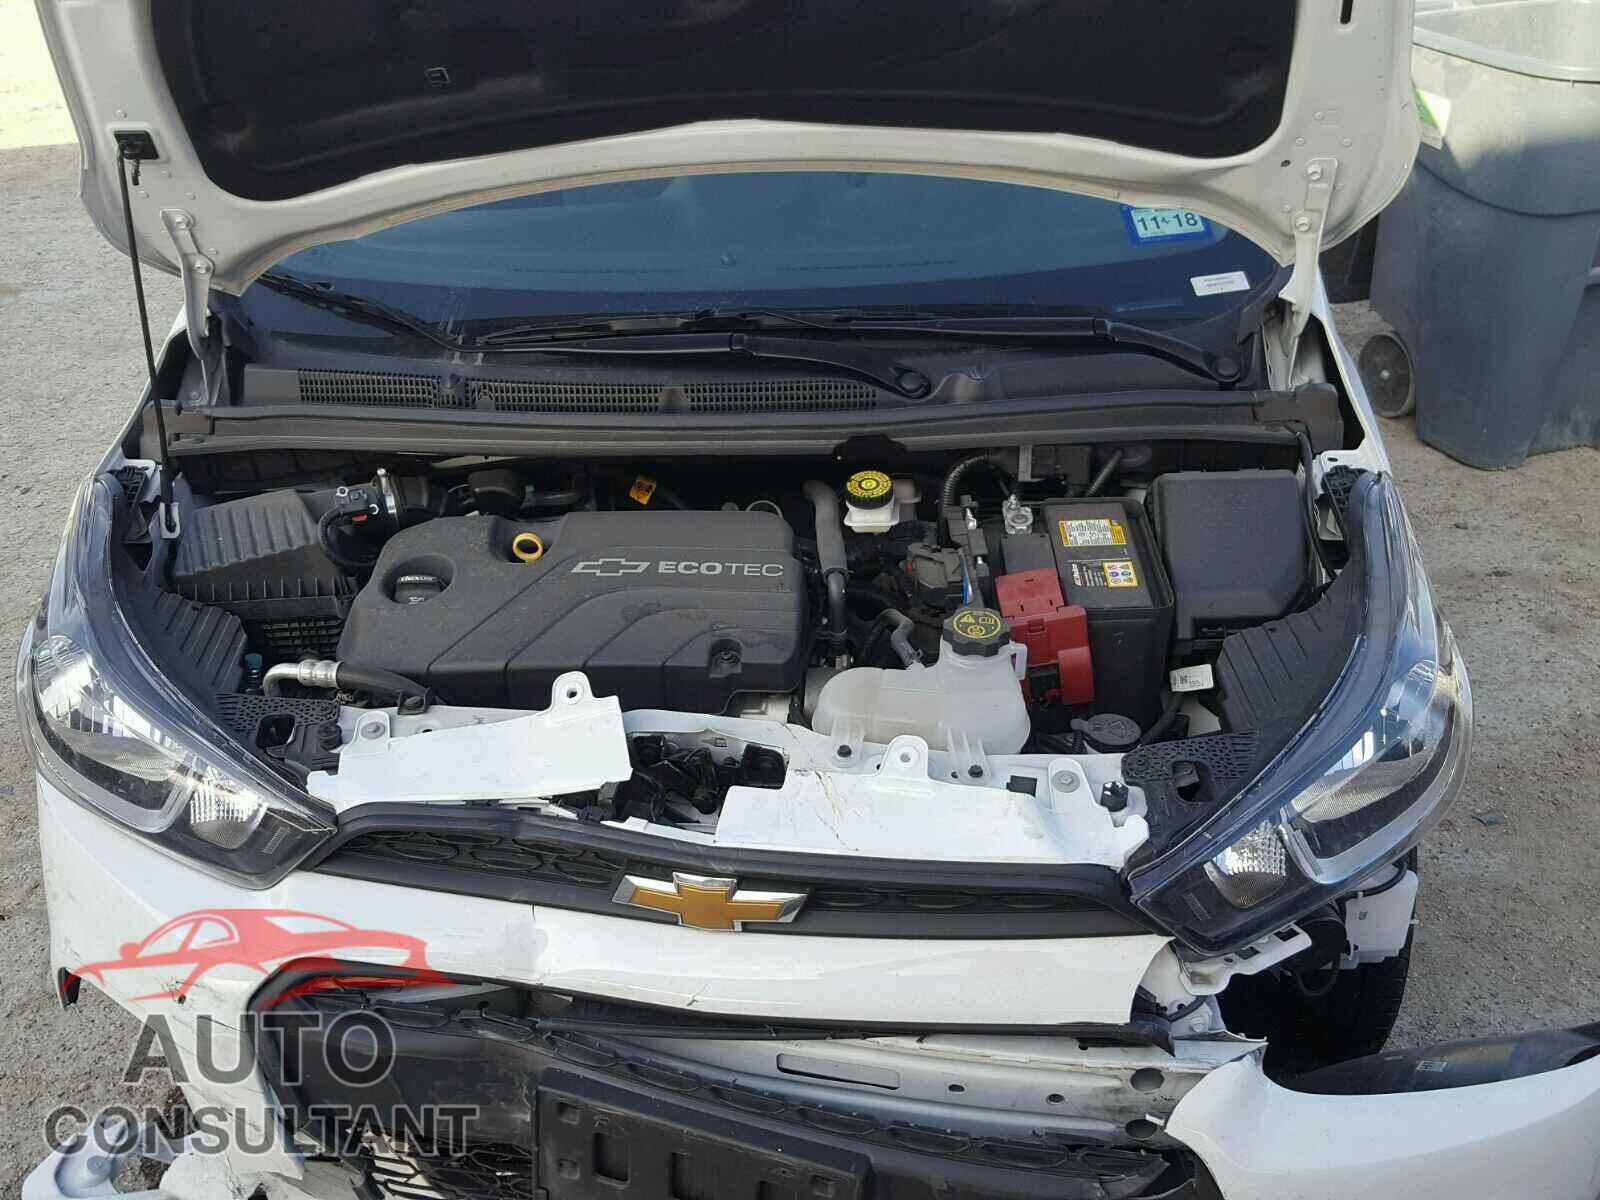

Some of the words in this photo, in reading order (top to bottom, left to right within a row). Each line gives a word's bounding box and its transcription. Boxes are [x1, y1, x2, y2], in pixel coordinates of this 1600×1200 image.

[1137, 216, 1161, 232] 11
[1173, 211, 1198, 228] 18
[657, 560, 784, 577] ECOTEC
